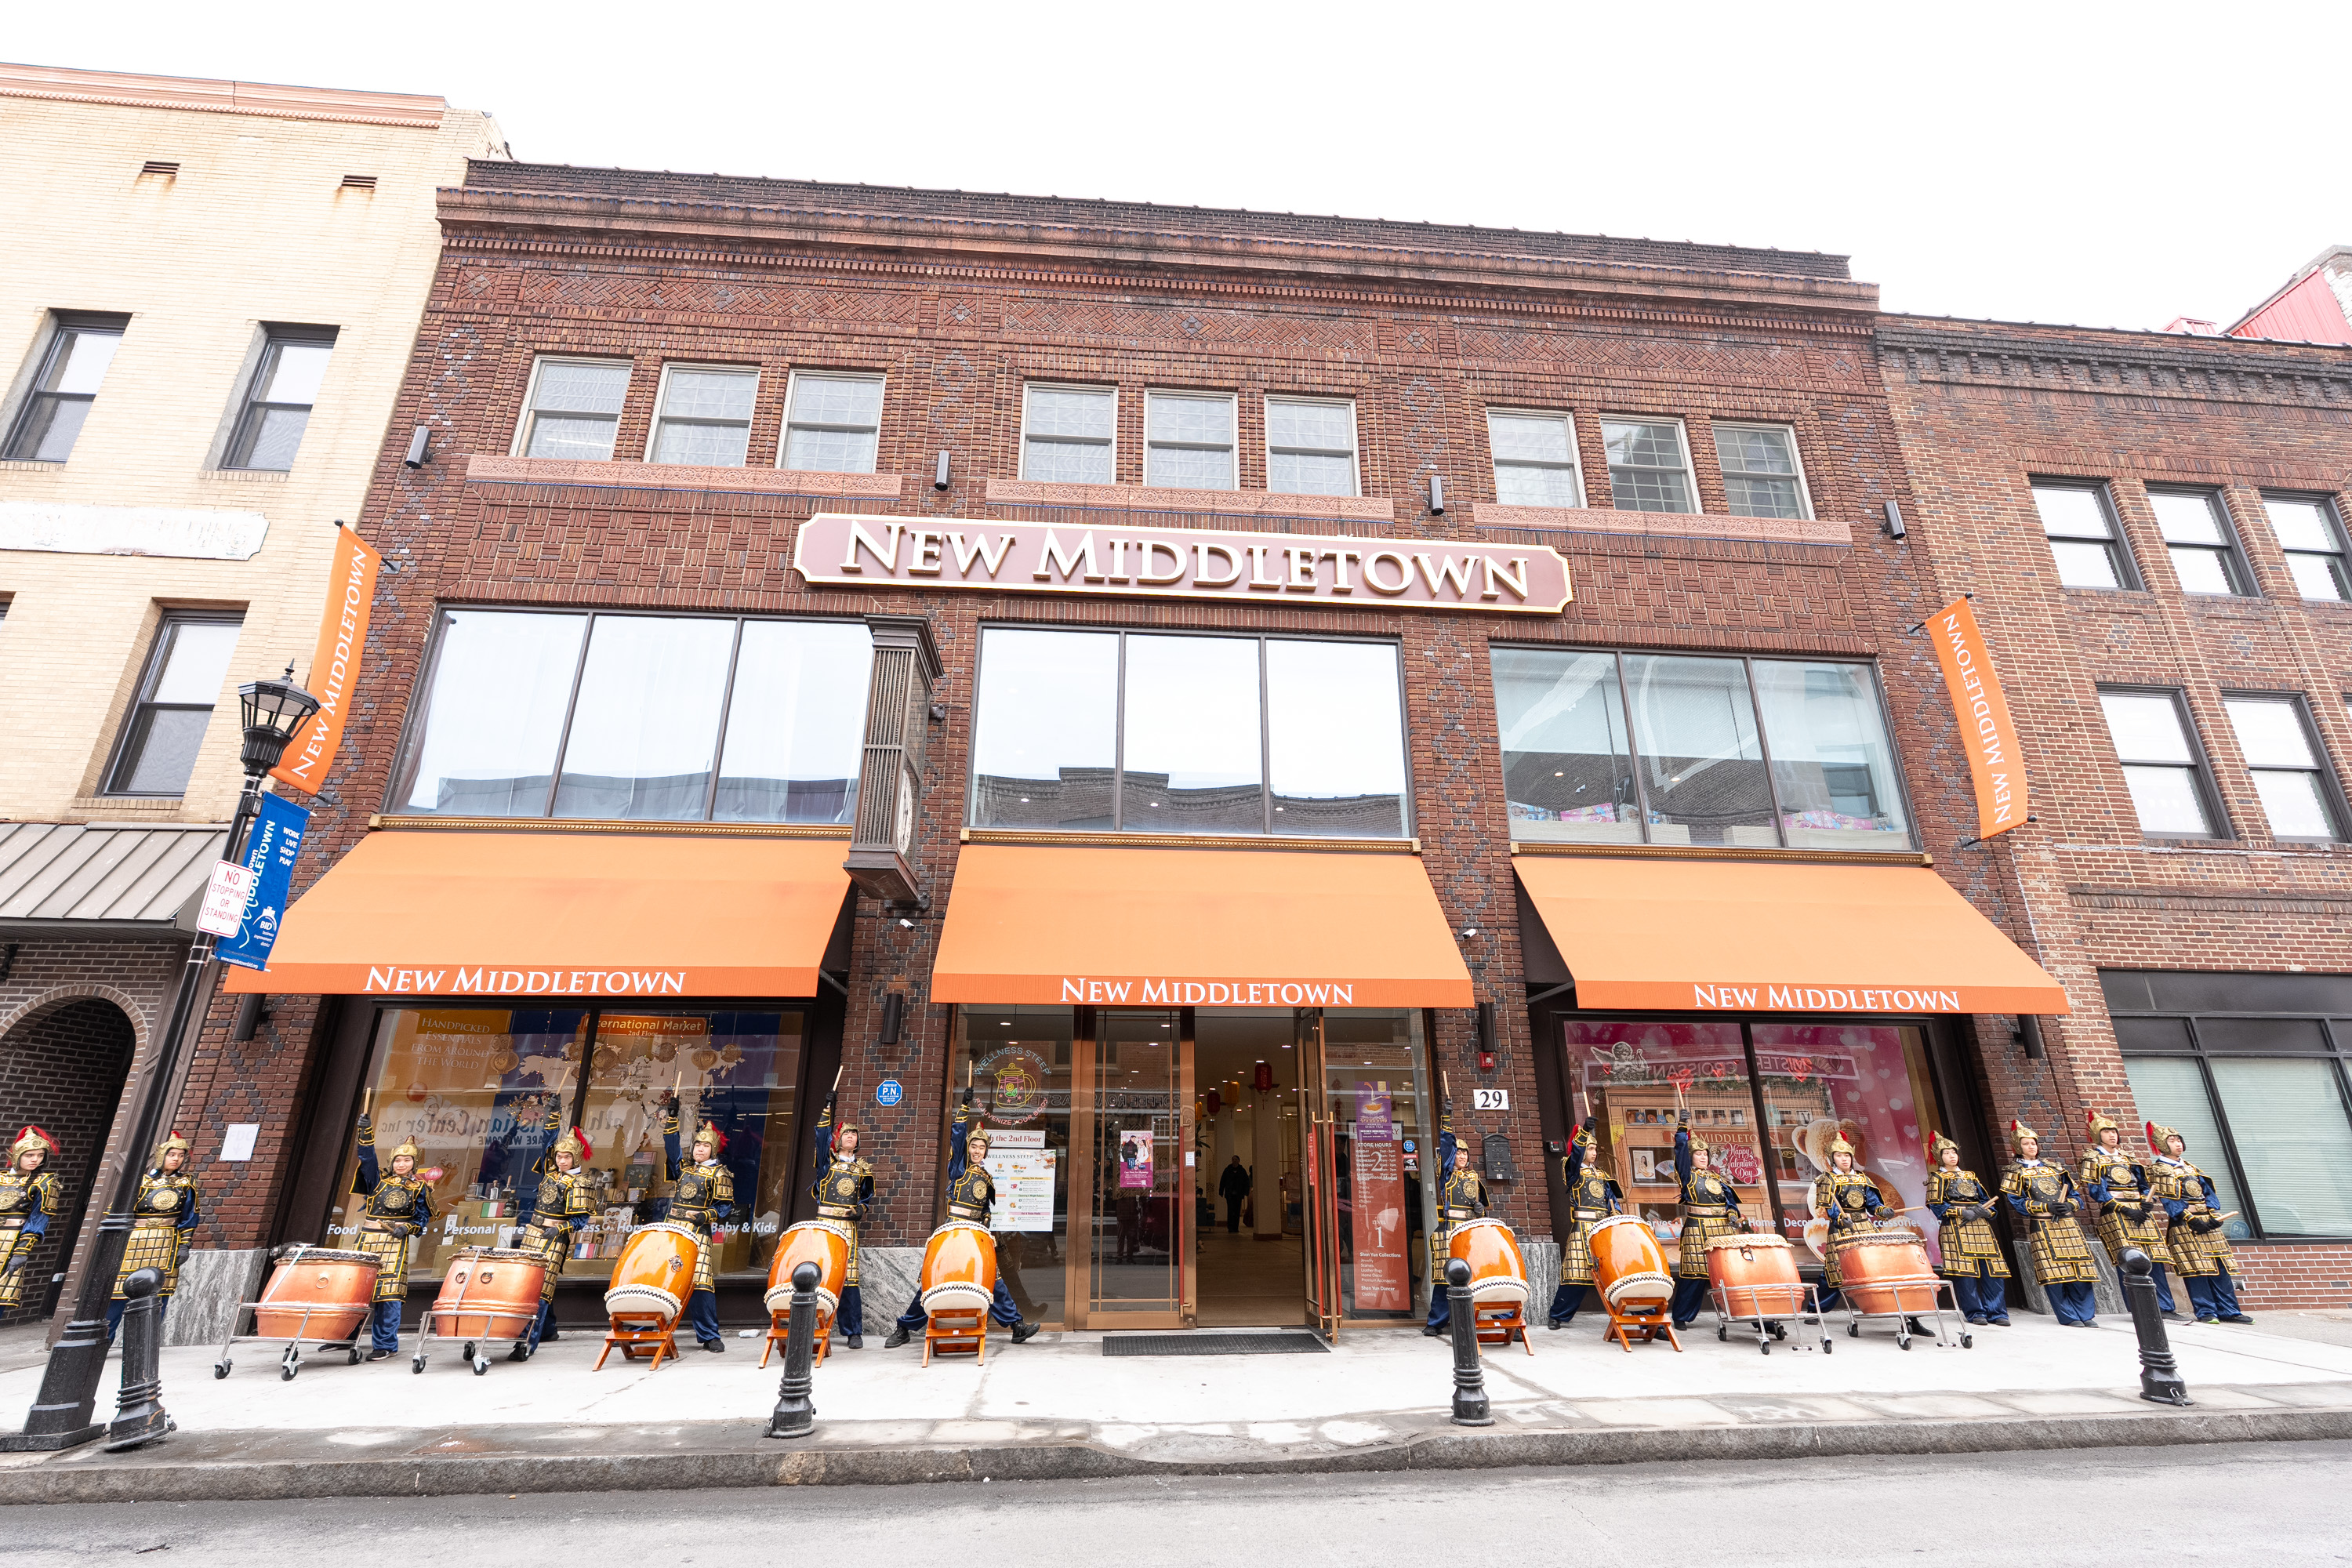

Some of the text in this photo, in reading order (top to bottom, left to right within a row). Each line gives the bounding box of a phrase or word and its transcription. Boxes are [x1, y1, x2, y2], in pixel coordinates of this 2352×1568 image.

[840, 521, 1530, 601] NEW MIDDLETOWN
[291, 544, 368, 781] NEW MIDDLETOWN
[1943, 613, 2012, 825] NEW MIDDLETOWN
[283, 826, 300, 840] WORK
[285, 838, 298, 848] LIVE
[279, 846, 295, 857] SHOP
[279, 856, 292, 866] PLAY
[224, 870, 240, 885] NO
[211, 883, 245, 900] STOPPING
[220, 898, 230, 908] OR
[205, 907, 238, 923] STANDING
[260, 920, 273, 931] BID
[362, 965, 687, 993] NEW MIDDLETOWN
[1060, 977, 1354, 1004] NEW MIDDLETOWN
[1693, 984, 1960, 1011] NEW MIDDLETOWN
[421, 1018, 490, 1034] HANDPICKED
[584, 1018, 702, 1031] Iternational Market
[426, 1030, 481, 1045] ESSENTIALS
[411, 1043, 490, 1058] FROM AROUND
[417, 1057, 479, 1070] THE WORLD
[975, 1047, 1052, 1076] WELLNESS STEEP
[882, 1087, 899, 1096] P.N.
[1479, 1091, 1503, 1109] 29
[975, 1098, 1012, 1126] REJUVENIZE
[1700, 1132, 1776, 1143] MIDDLETON
[1724, 1142, 1750, 1160] Happy
[1371, 1151, 1383, 1171] 2
[1735, 1167, 1756, 1185] Day
[327, 1223, 358, 1236] Food
[445, 1223, 525, 1236] Personal Cre
[617, 1221, 642, 1233] Hom
[711, 1221, 777, 1236] Baby & Kids
[1748, 1217, 1776, 1228] Home
[1374, 1226, 1385, 1248] 1
